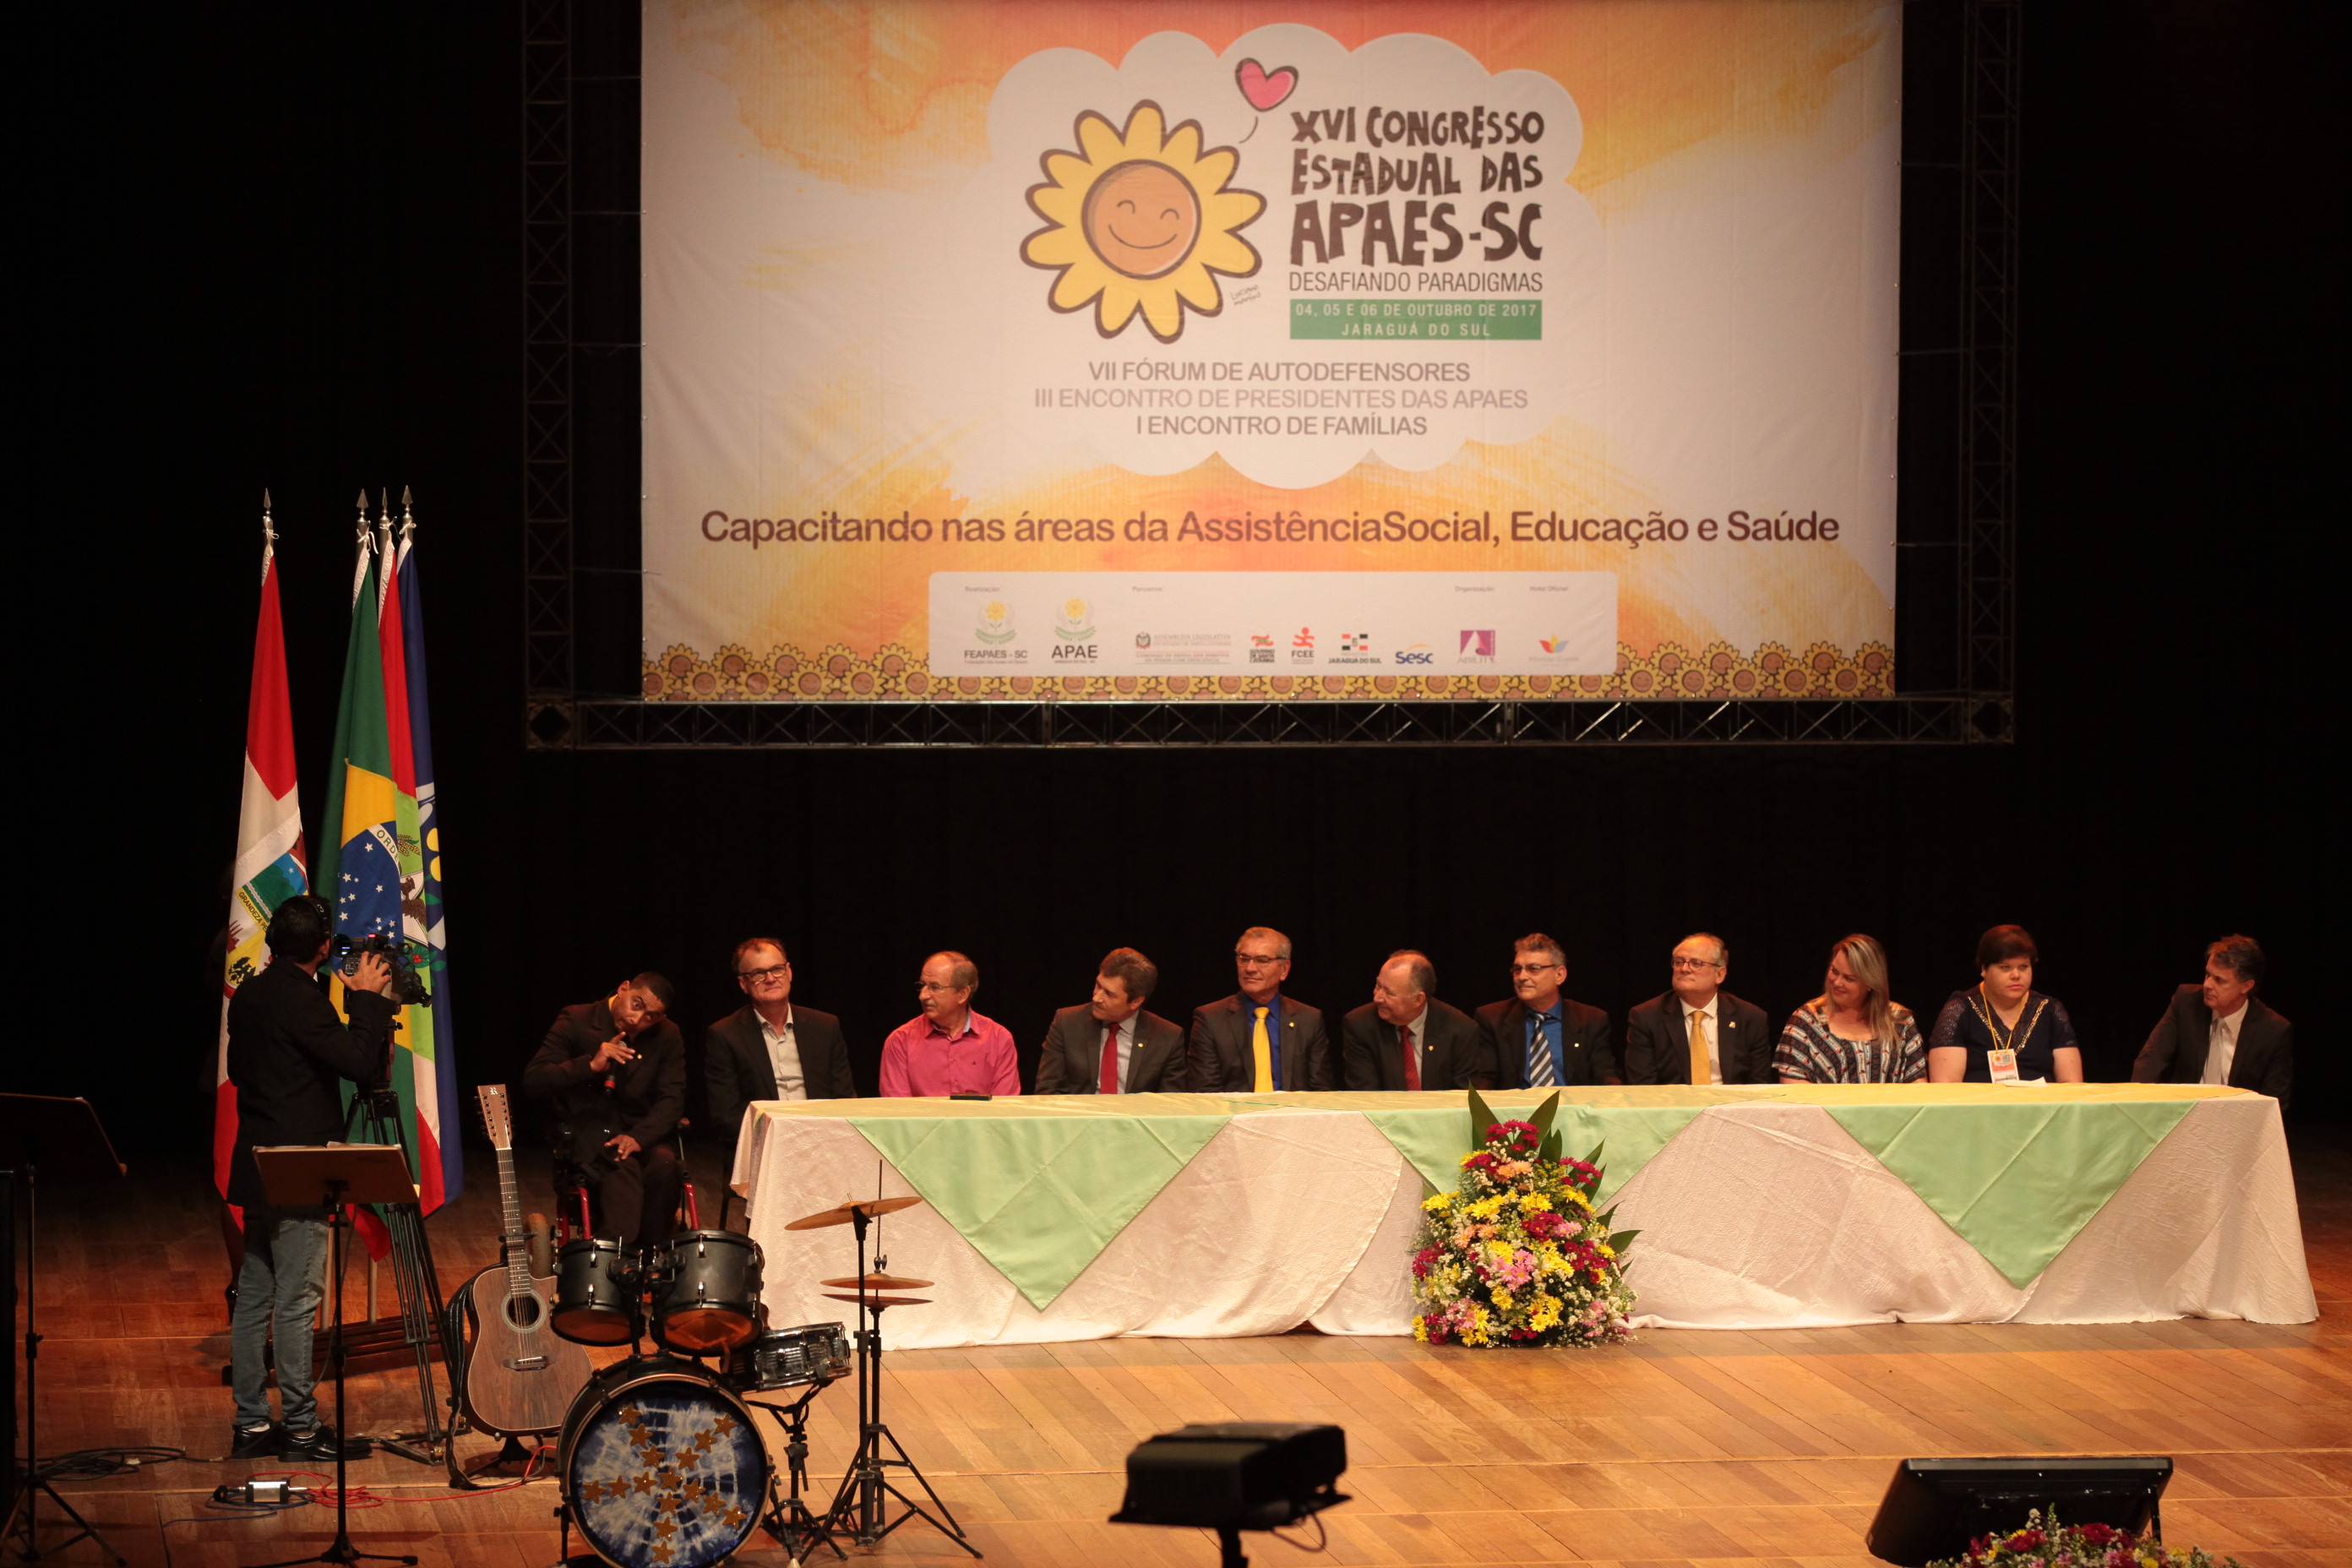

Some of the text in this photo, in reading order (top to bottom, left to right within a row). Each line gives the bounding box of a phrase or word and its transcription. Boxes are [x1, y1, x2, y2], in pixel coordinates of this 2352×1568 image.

[1290, 105, 1545, 150] XVI CONGRESSO
[1291, 148, 1544, 197] ESTADUAL DAS
[1290, 199, 1544, 268] APAES-SC
[1289, 271, 1544, 293] DESAFIANDO PARADIGMAS
[1295, 302, 1537, 317] 04, 05 E 06 DE OUTUBRO DE 2017
[1341, 321, 1490, 337] JARAGUÁ DO SUL
[1088, 357, 1471, 383] VII FÓRUM DE AUTODEFENSORES
[1034, 388, 1529, 410] III ENCONTRO DE PRESIDENTES DAS APAES
[1136, 411, 1428, 436] I ENCONTRO DE FAMÍLIAS
[700, 509, 1840, 551] Capacitando nas áreas da AssistênciaSocial, Educação e Saúde
[963, 650, 1008, 659] FEAPAES
[1014, 649, 1028, 659] SC
[1051, 645, 1098, 659] APAE
[1291, 650, 1315, 658] FCEE
[1395, 651, 1434, 665] Sesc
[239, 891, 263, 923] GRANDEZA
